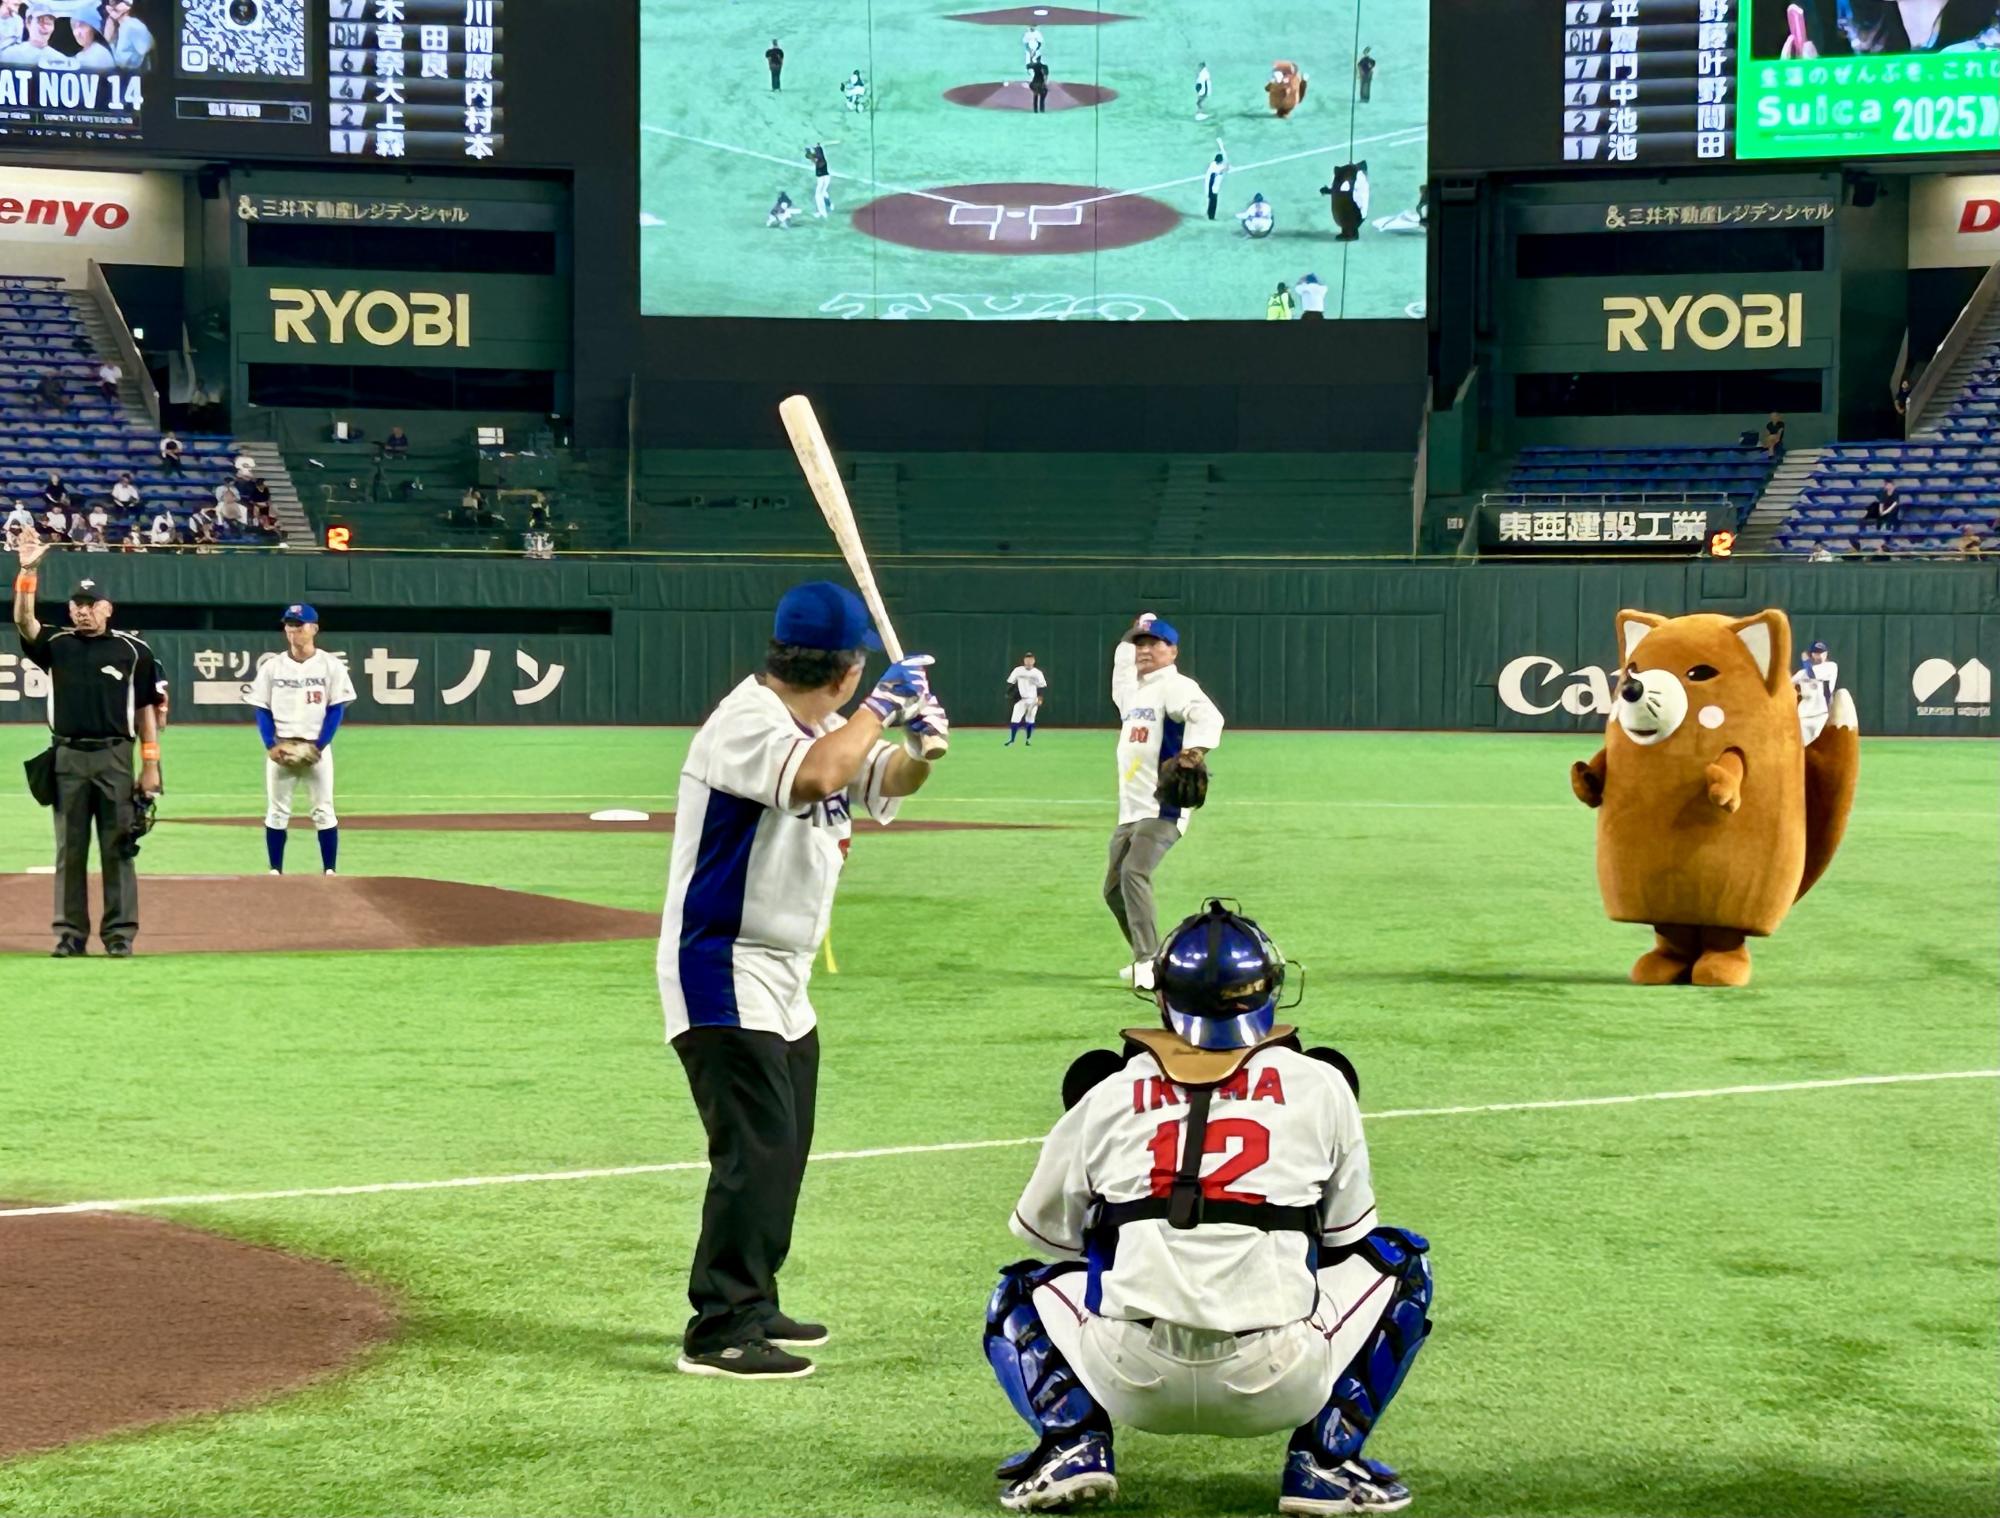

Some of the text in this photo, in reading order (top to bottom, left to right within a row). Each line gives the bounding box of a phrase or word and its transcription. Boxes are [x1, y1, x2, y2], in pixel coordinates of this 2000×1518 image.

[1575, 4, 1589, 24] 6
[341, 53, 354, 72] 6
[1575, 58, 1588, 80] 7
[40, 71, 99, 109] NOV
[107, 75, 144, 111] 14
[376, 77, 493, 107] 大内
[1572, 85, 1588, 106] 4
[341, 104, 493, 133] 2 上村
[1574, 112, 1588, 133] 2
[1757, 94, 1882, 127] Suica
[342, 133, 351, 153] 1
[1575, 139, 1583, 161] 1
[0, 198, 129, 237] enyo
[270, 288, 470, 347] RYOBI
[1603, 293, 1802, 352] RYOBI
[327, 527, 350, 551] 2
[1500, 511, 1707, 541] 東亜建設工業
[1711, 531, 1733, 556] 2
[364, 648, 565, 705] セノン
[1498, 655, 1620, 715] Ca
[1133, 1067, 1286, 1115] IKMA
[1147, 1118, 1270, 1204] 12
